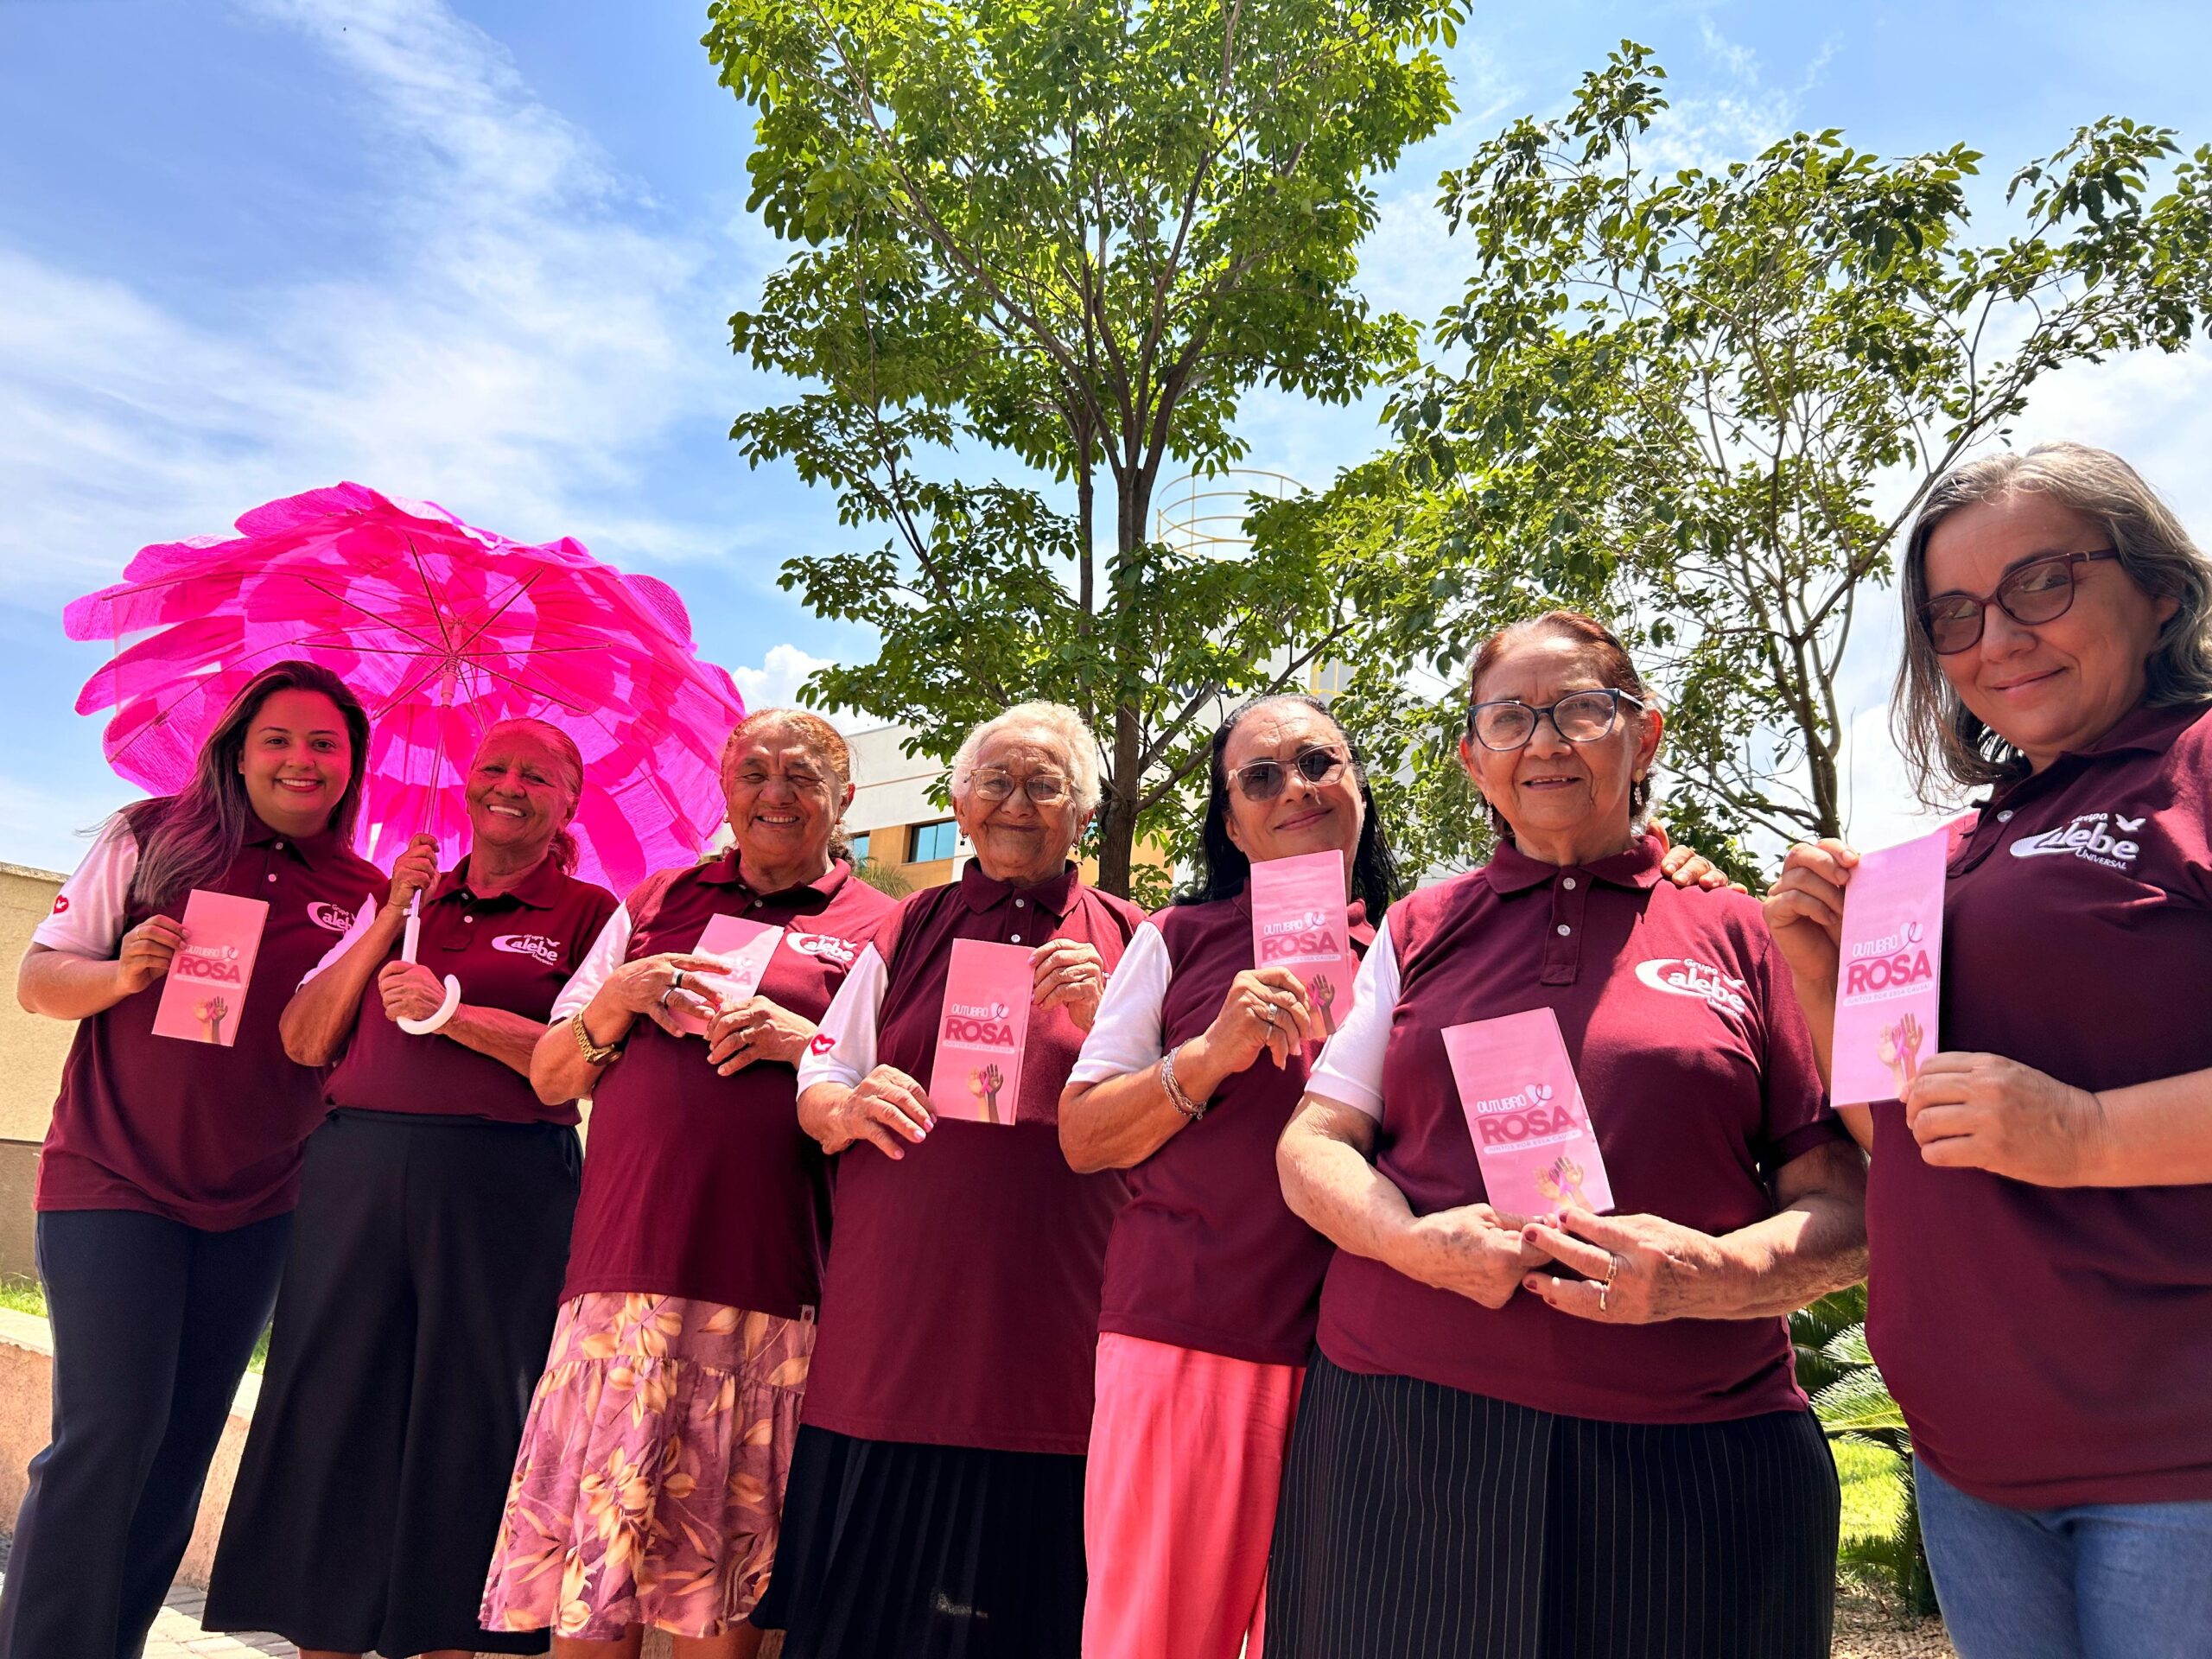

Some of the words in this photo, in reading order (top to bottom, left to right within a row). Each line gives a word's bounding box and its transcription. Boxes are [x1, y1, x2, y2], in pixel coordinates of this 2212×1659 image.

[2075, 847, 2126, 869] UNIVERSAL
[307, 901, 354, 931] Caleb
[332, 904, 349, 916] Grupo
[1264, 919, 1303, 935] OUTUBRO
[491, 934, 558, 962] Calebe
[785, 931, 855, 962] Calebe
[1262, 931, 1339, 961] ROSA
[1852, 934, 1898, 957] OUTUBRO
[176, 956, 241, 983] ROSA
[1684, 958, 1719, 976] Grupo
[1847, 950, 1933, 995] ROSA
[1635, 958, 1745, 1014] Calebe
[952, 1003, 989, 1017] OUTUBRO
[945, 1019, 1014, 1046] ROSA
[1477, 1094, 1527, 1114] OUTUBRO
[1478, 1106, 1578, 1145] ROSA
[1552, 1130, 1579, 1141] CAUA!
